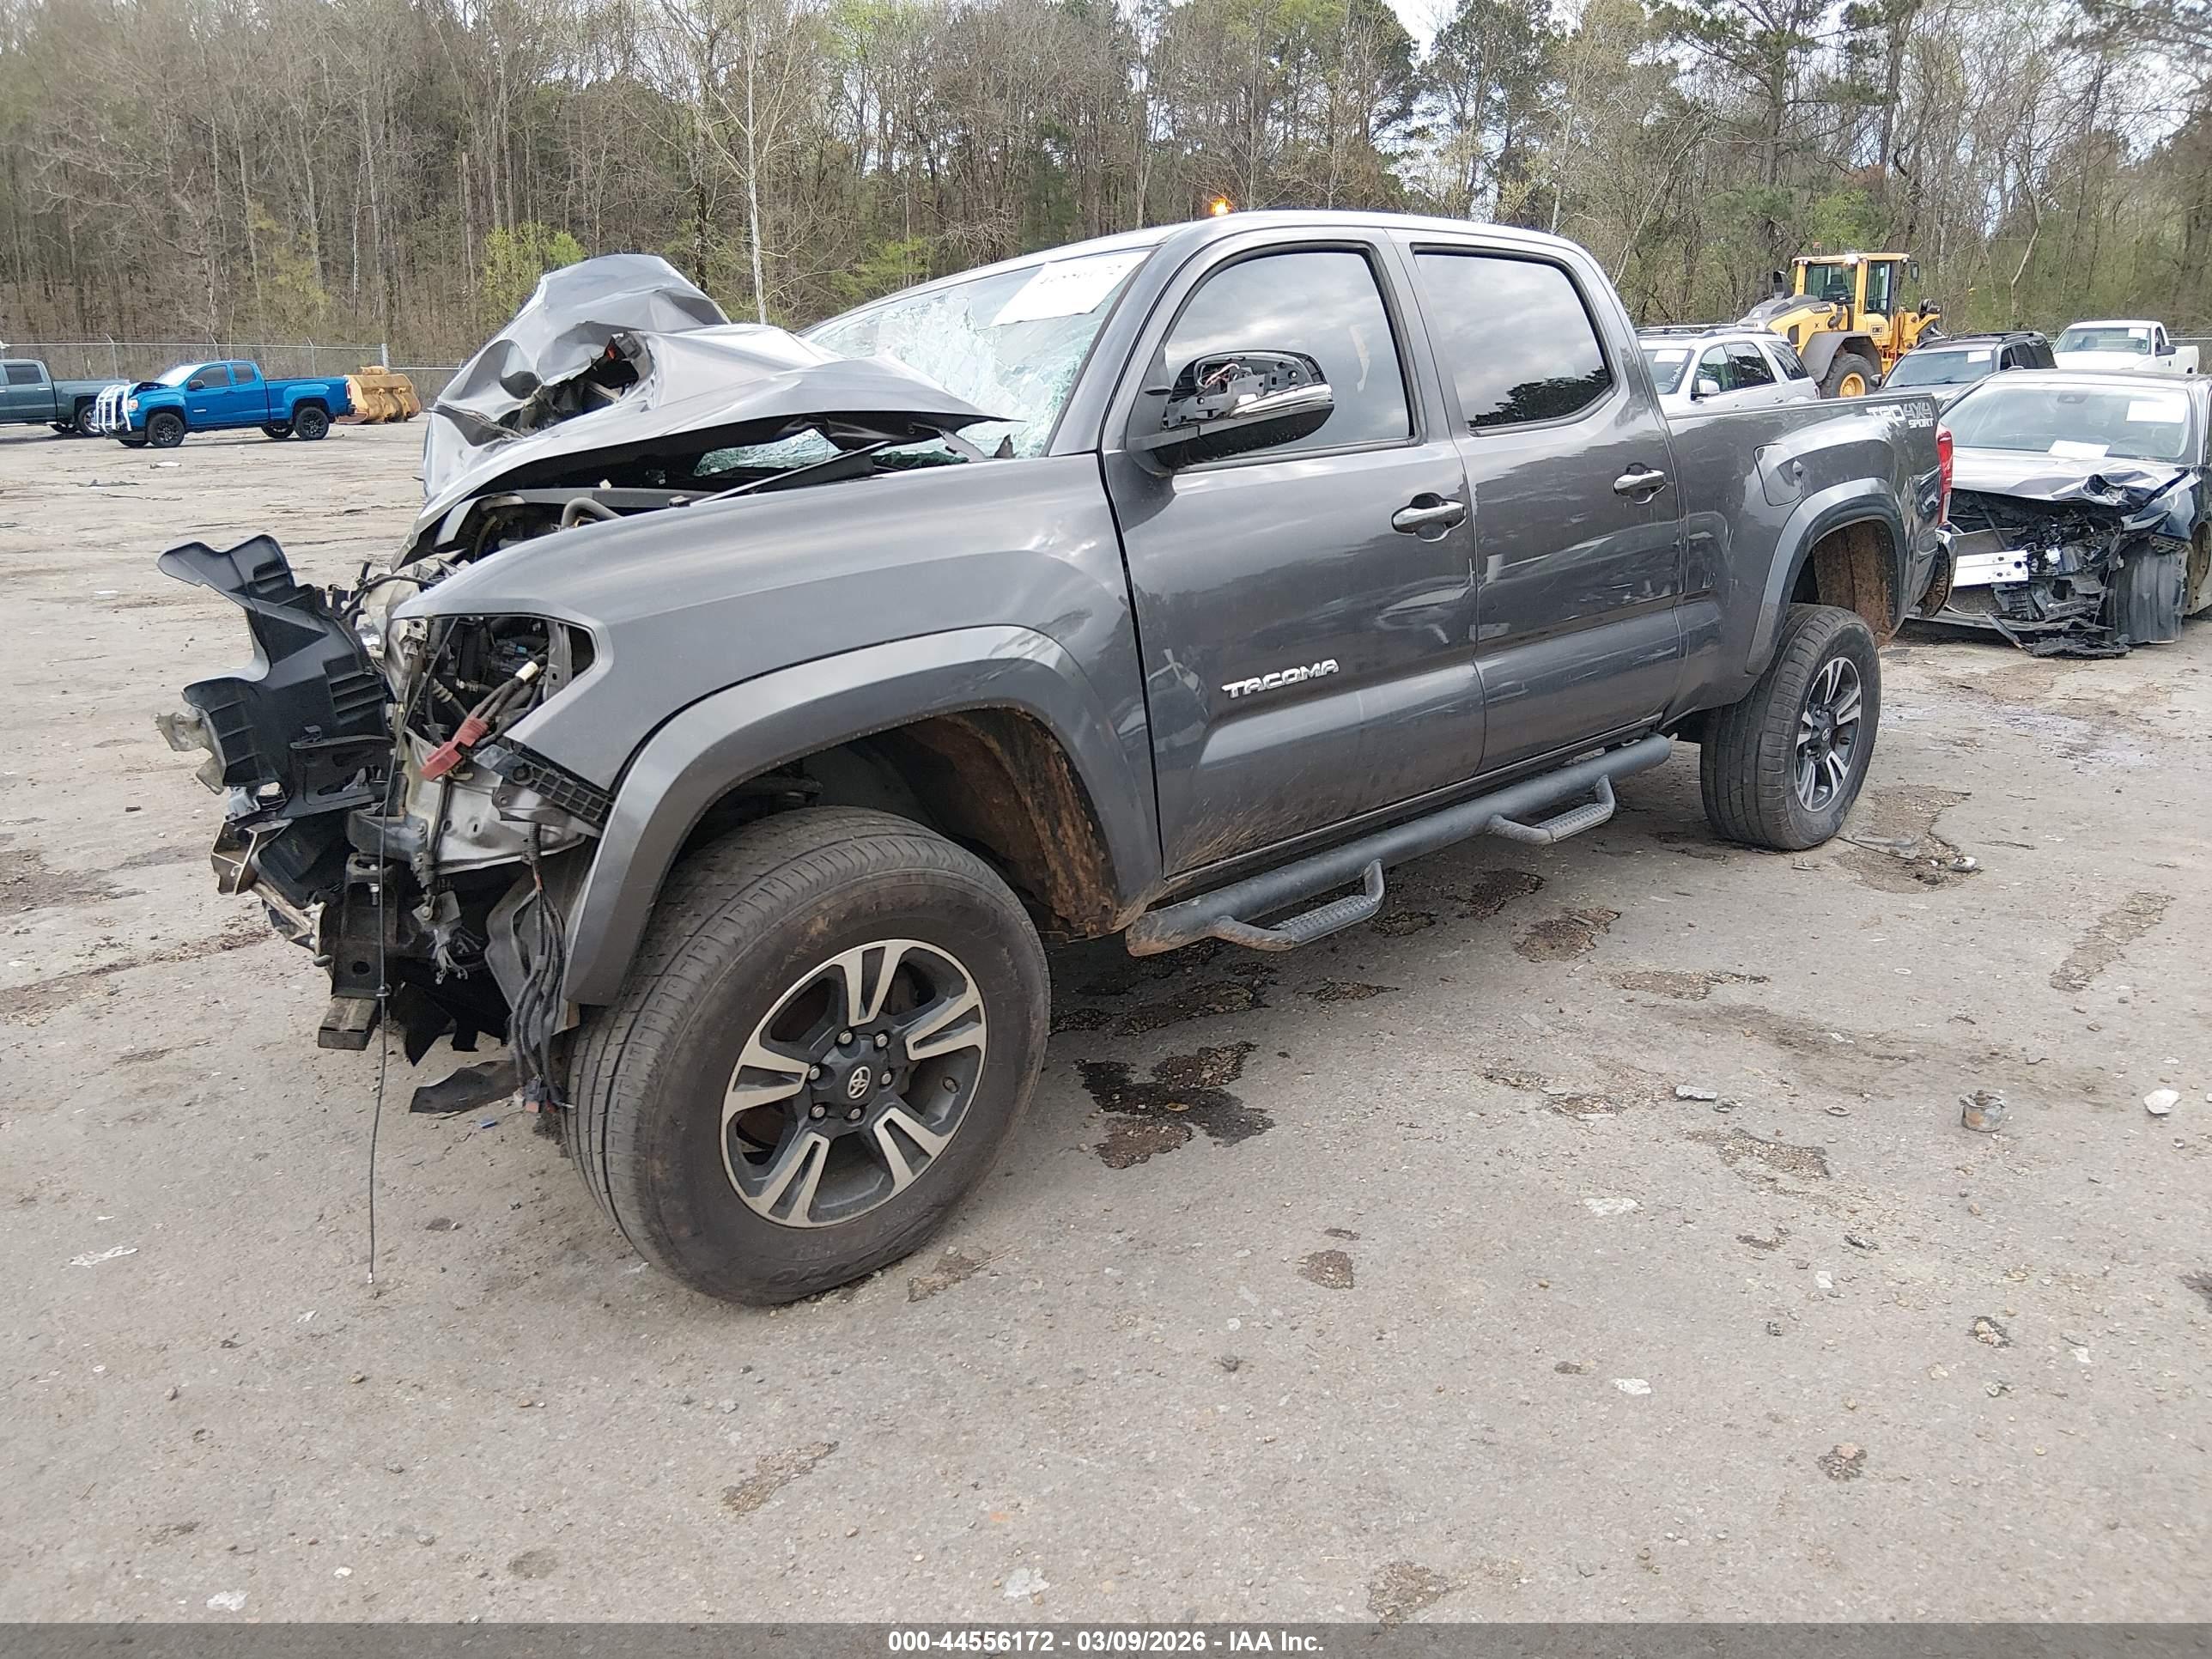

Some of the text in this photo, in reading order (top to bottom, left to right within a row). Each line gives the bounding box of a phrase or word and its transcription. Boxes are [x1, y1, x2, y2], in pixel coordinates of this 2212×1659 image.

[1866, 404, 1906, 428] TRD
[1908, 418, 1934, 428] SPORT
[1221, 659, 1340, 698] TACOMA
